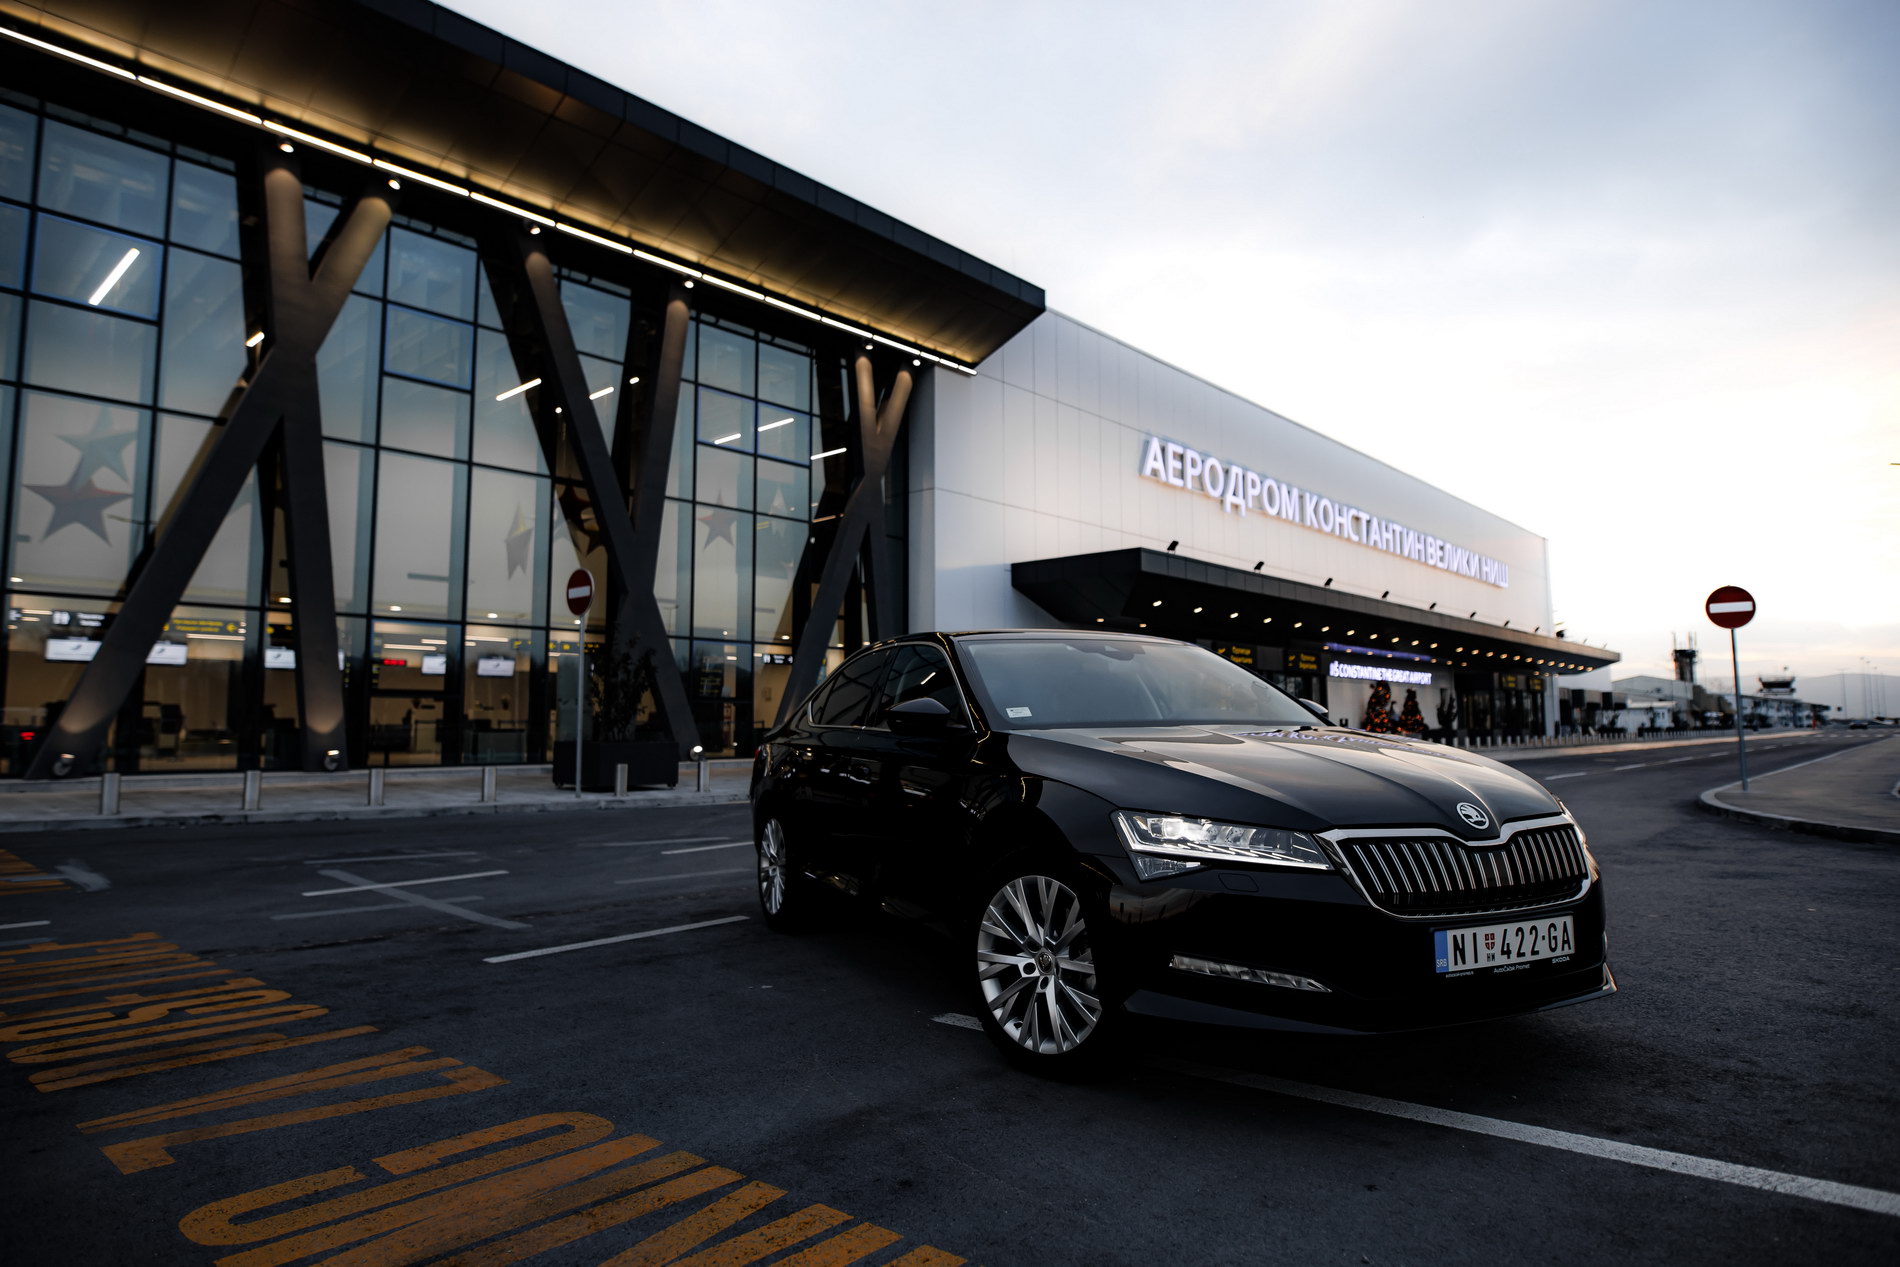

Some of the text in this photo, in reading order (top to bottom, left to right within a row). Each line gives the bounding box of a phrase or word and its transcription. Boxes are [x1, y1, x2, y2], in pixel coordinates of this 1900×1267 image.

[1142, 436, 1509, 588] АЕРОДРОМ КОНСТАНТИН ВЕЛИКИ НИШ
[1340, 664, 1383, 680] CONSTANTINE
[1392, 669, 1410, 684] GREAT
[1410, 671, 1432, 685] AIRPORT
[1435, 958, 1447, 968] SRB
[1452, 932, 1479, 966] NI
[75, 1045, 510, 1175] ZA
